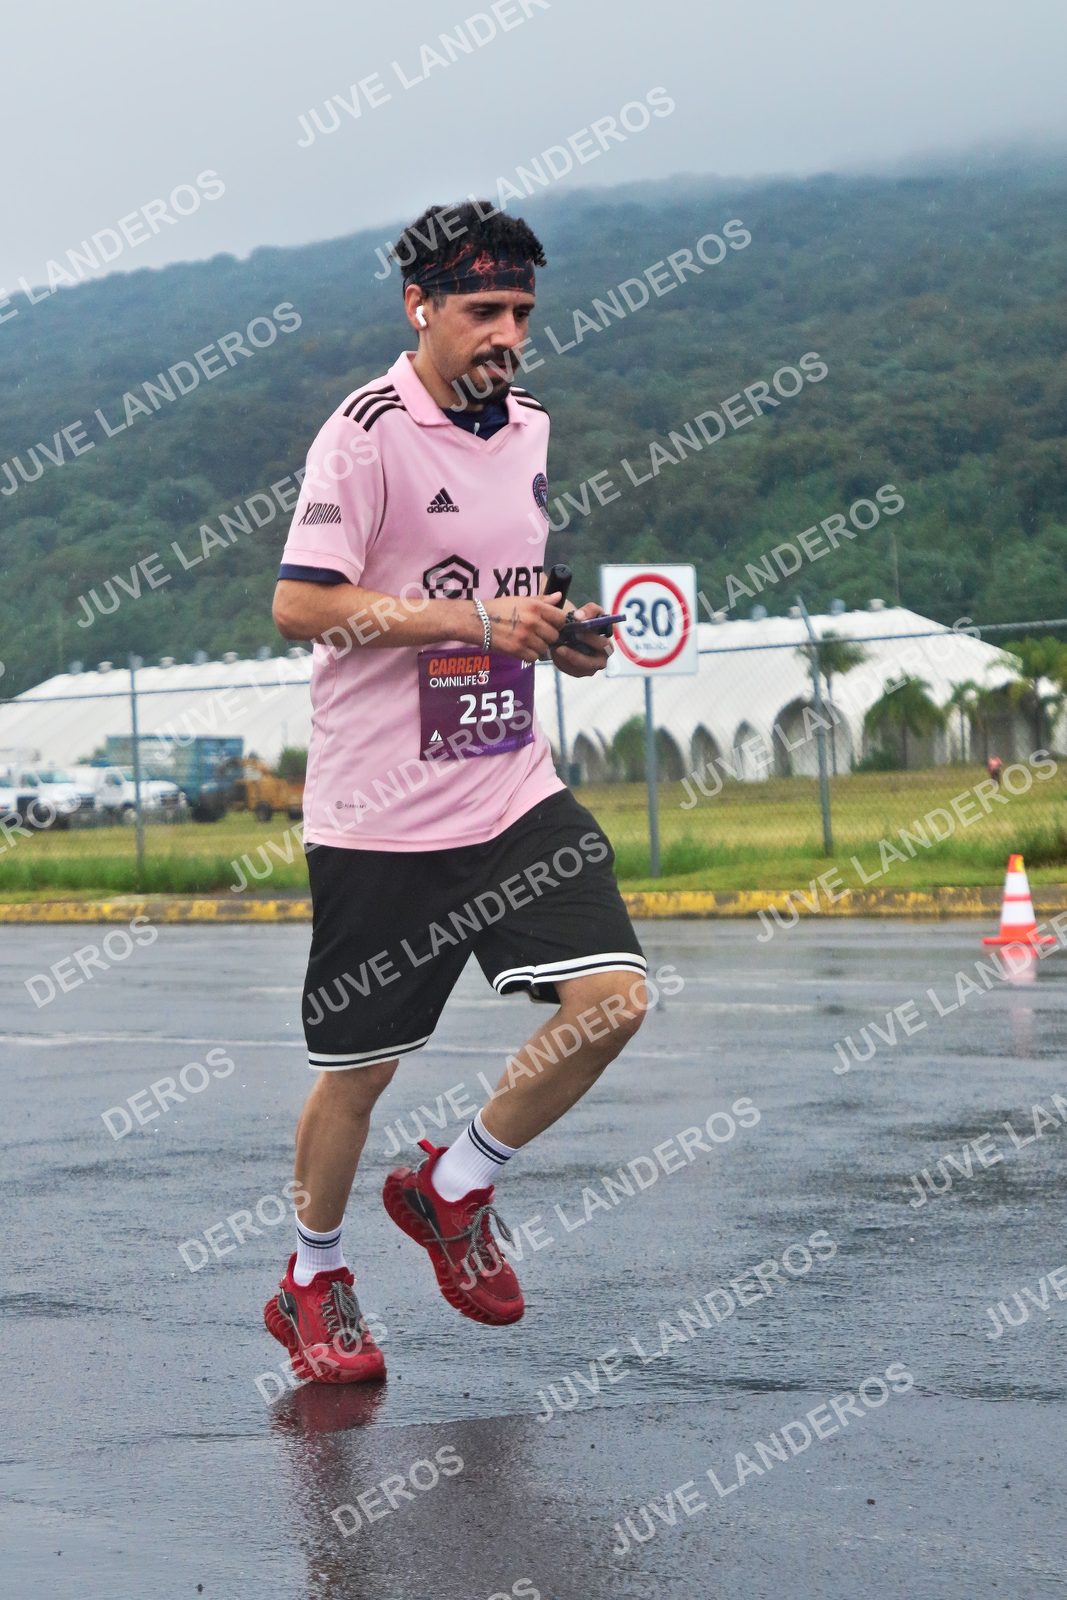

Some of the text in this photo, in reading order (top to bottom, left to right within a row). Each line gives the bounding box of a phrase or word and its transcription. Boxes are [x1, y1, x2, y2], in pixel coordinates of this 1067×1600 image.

[427, 504, 459, 514] adidas
[625, 598, 673, 636] 30
[429, 656, 490, 675] CARRERA
[460, 689, 515, 724] 253
